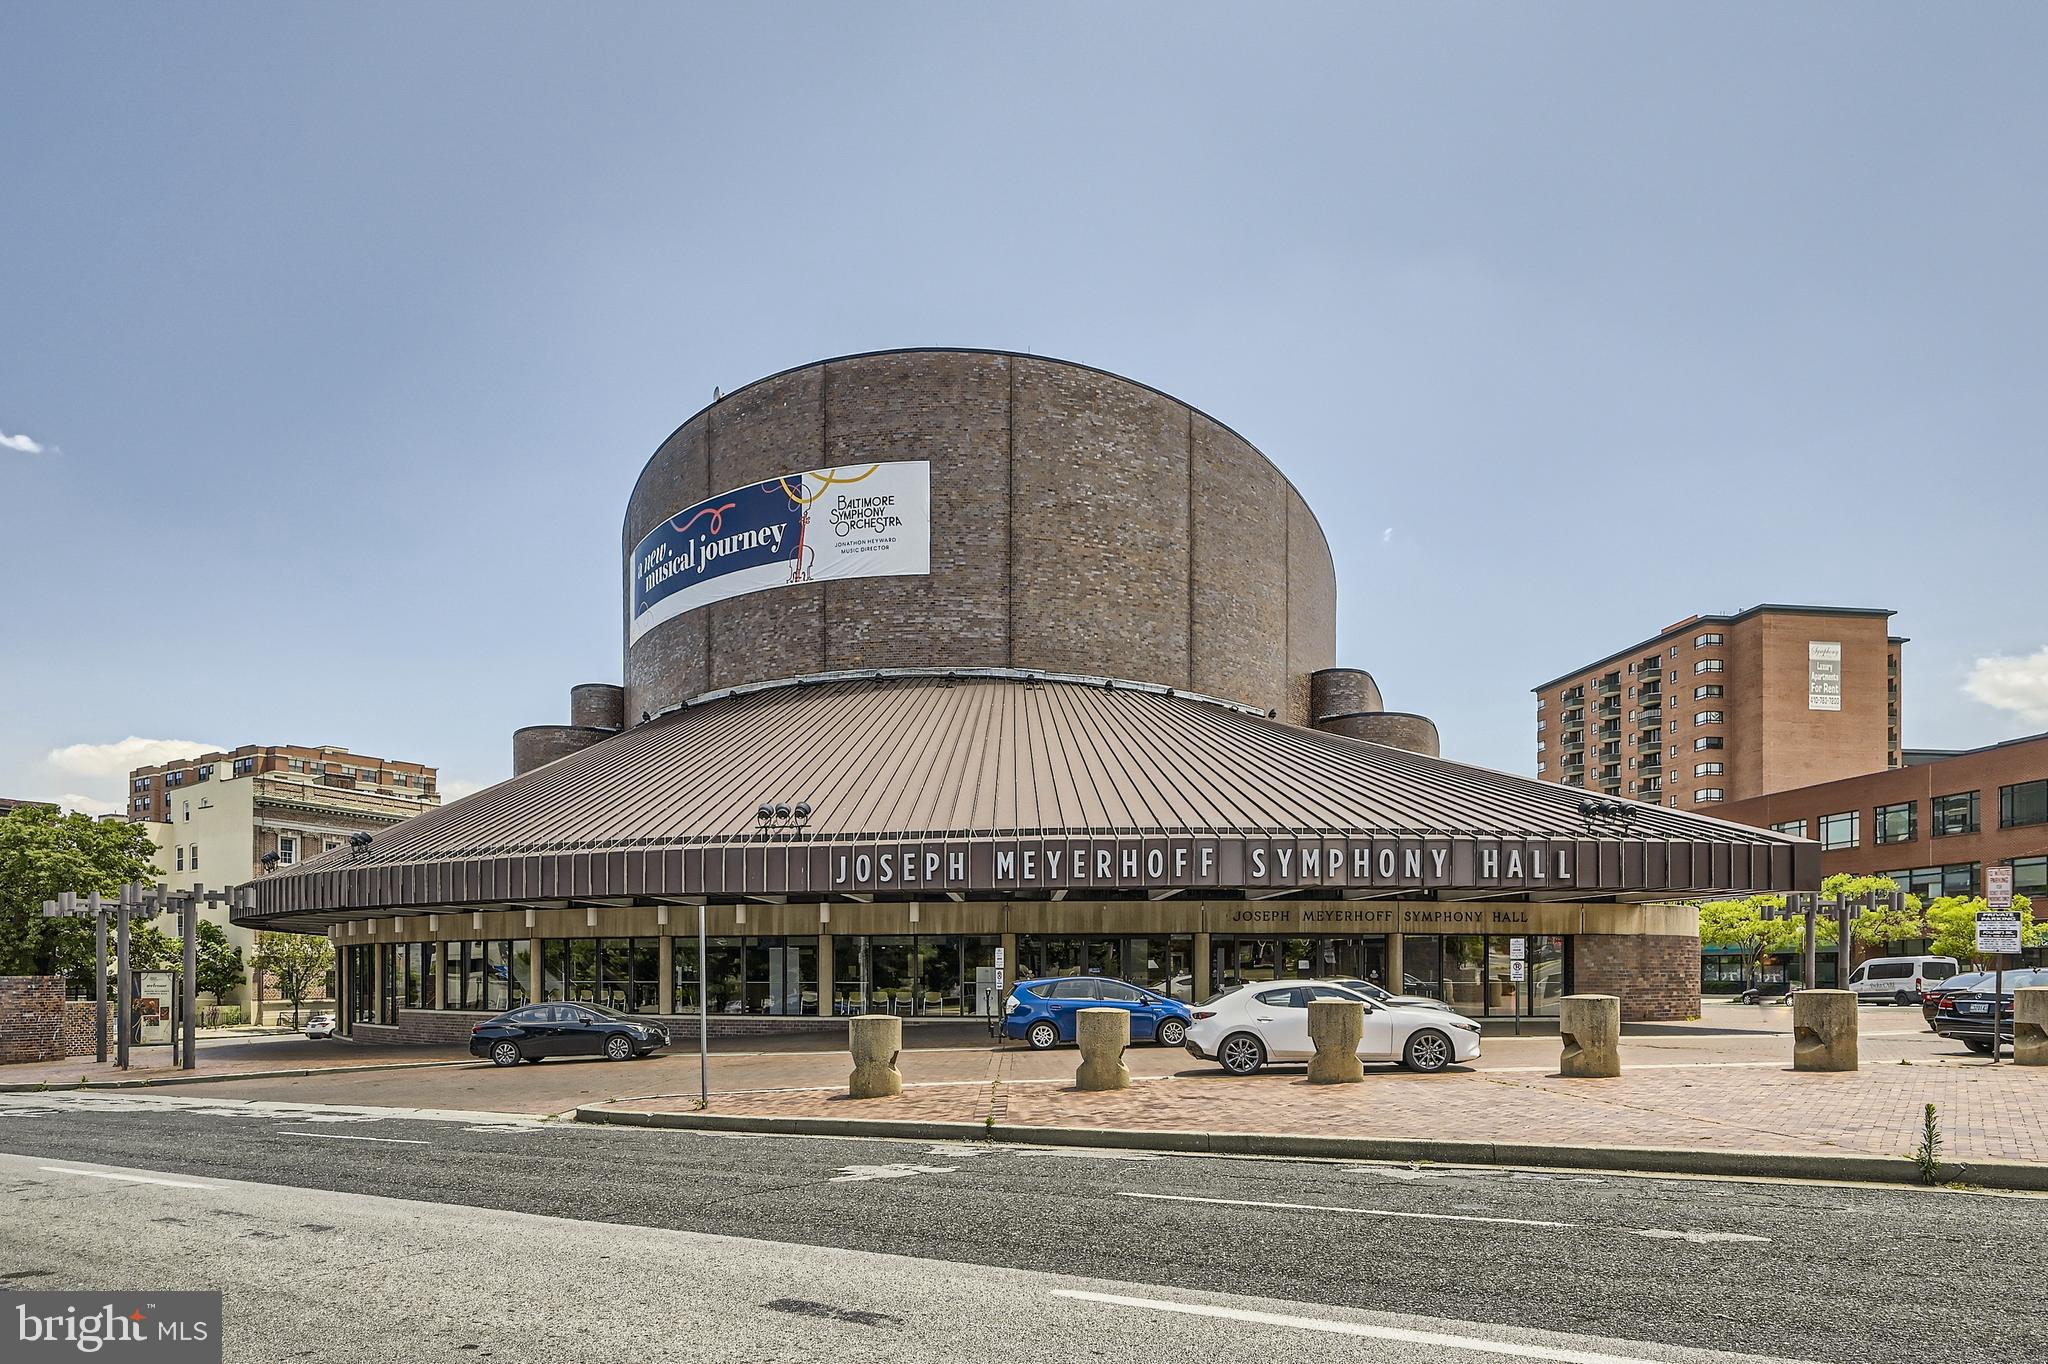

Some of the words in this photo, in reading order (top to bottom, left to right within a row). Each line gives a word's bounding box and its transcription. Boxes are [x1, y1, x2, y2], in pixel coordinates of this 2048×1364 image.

[837, 495, 895, 510] BALTIMORE
[829, 507, 886, 524] SYMPHONY
[835, 516, 903, 537] ORCHESTRA
[834, 540, 866, 548] JONATHON
[867, 537, 897, 545] HEYWARD
[860, 545, 890, 553] DIRECTOR
[637, 562, 643, 580] a
[643, 542, 667, 574] new
[645, 539, 696, 593] musical
[696, 522, 788, 573] journey
[1816, 661, 1833, 673] Luxury
[1811, 671, 1839, 682] Apartments
[1811, 682, 1822, 693] For
[1823, 682, 1839, 694] Rent
[836, 852, 964, 883] JOSEPH
[997, 848, 1213, 880] MEYERHOFF
[1252, 848, 1447, 878] SYMPHONY
[1483, 849, 1571, 879] HALL
[1233, 910, 1290, 922] JOSEPH
[1303, 910, 1393, 922] MEYERHOFF
[1404, 911, 1483, 923] SYMPHONY
[1493, 911, 1528, 923] HALL
